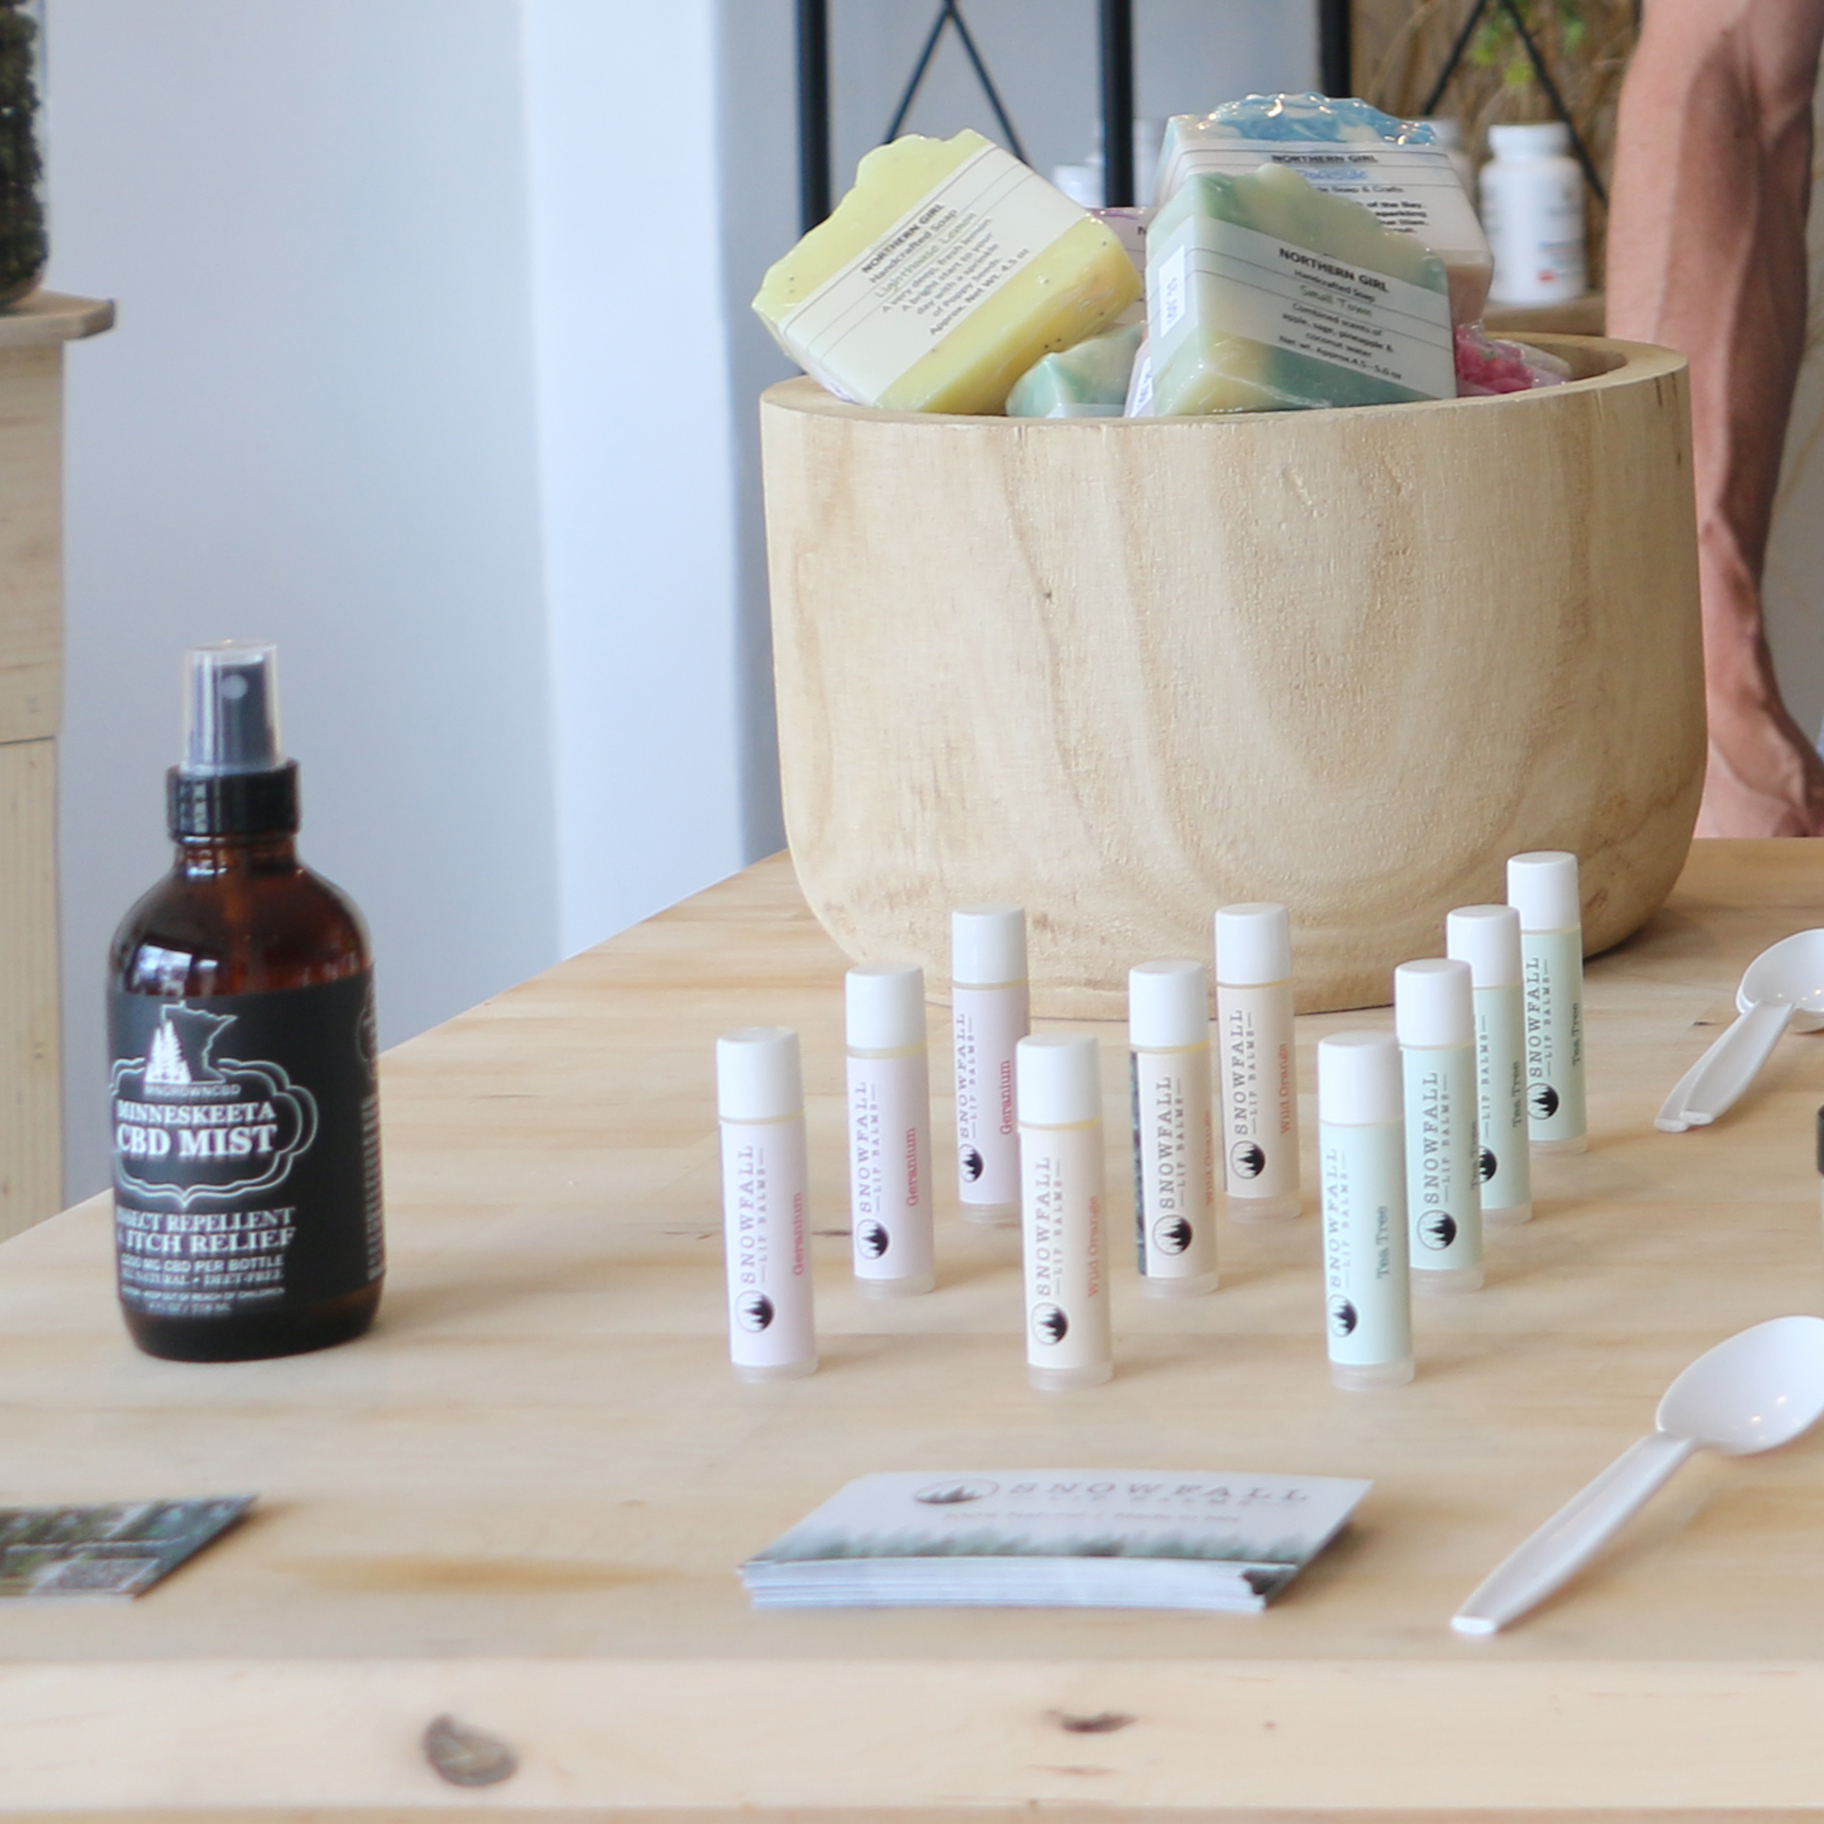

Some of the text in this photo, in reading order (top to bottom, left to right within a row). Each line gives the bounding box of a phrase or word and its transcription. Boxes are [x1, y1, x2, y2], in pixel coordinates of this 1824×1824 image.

[861, 203, 944, 274] NORTHERN GIRL
[1279, 247, 1389, 293] NORTHERN GIRL
[1526, 956, 1542, 1078] SNOWFALL
[956, 1014, 969, 1139] SNOWFALL
[1000, 1059, 1012, 1136] Geranium
[1230, 1009, 1248, 1136] SNOWFALL
[116, 1124, 277, 1157] CBD MIST
[854, 1080, 873, 1214] SNOWFALL
[907, 1127, 918, 1207] Geranium
[1159, 1076, 1175, 1210] SNOWFALL
[1423, 1072, 1440, 1205] SNOWFALL
[126, 1227, 296, 1253] ITCH RELIEF
[164, 1207, 296, 1233] REPELLENT
[228, 1254, 284, 1272] BOTTLE
